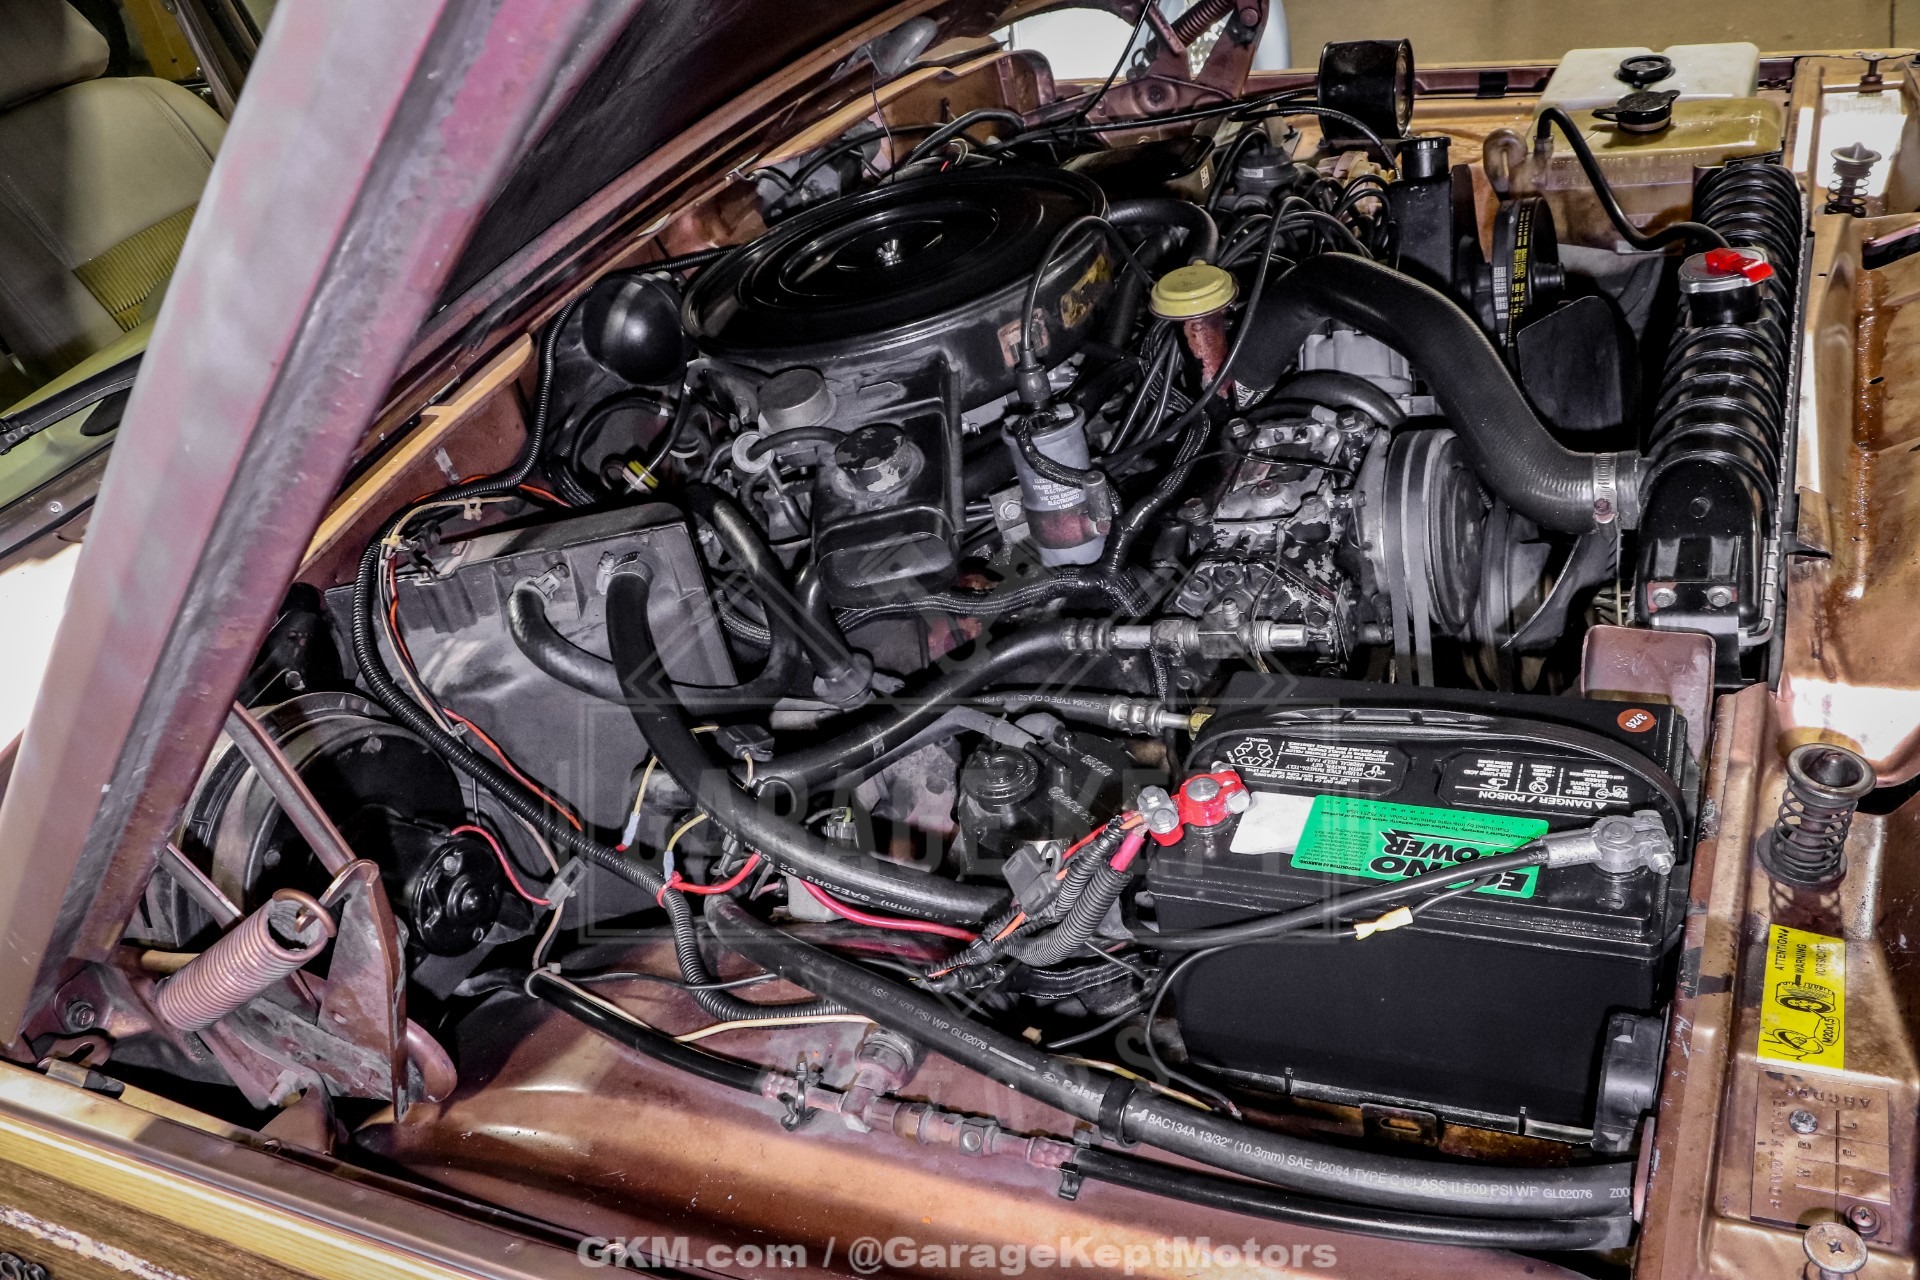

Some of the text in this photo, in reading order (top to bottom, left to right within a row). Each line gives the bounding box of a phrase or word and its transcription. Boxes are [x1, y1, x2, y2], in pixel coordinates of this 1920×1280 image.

[1051, 696, 1071, 704] TYPE
[1478, 789, 1525, 802] POISON
[1538, 795, 1592, 808] DANGER
[1379, 830, 1500, 863] OWER
[1774, 932, 1788, 970] ATTENTION
[1794, 943, 1807, 974] WARNING
[932, 1017, 950, 1030] WP
[950, 1027, 988, 1050] GL02076
[1148, 1113, 1196, 1138] 8AC134A
[1235, 1141, 1285, 1165] (10.3mm)
[1287, 1154, 1313, 1170] SAE
[1314, 1162, 1349, 1177] J2064
[1353, 1169, 1387, 1184] TYPE
[1391, 1175, 1400, 1186] C
[1403, 1177, 1447, 1192] CLASS
[1463, 1183, 1486, 1195] 500
[1490, 1184, 1513, 1196] PSI
[1516, 1186, 1539, 1197] WP
[1543, 1188, 1593, 1199] GL02076
